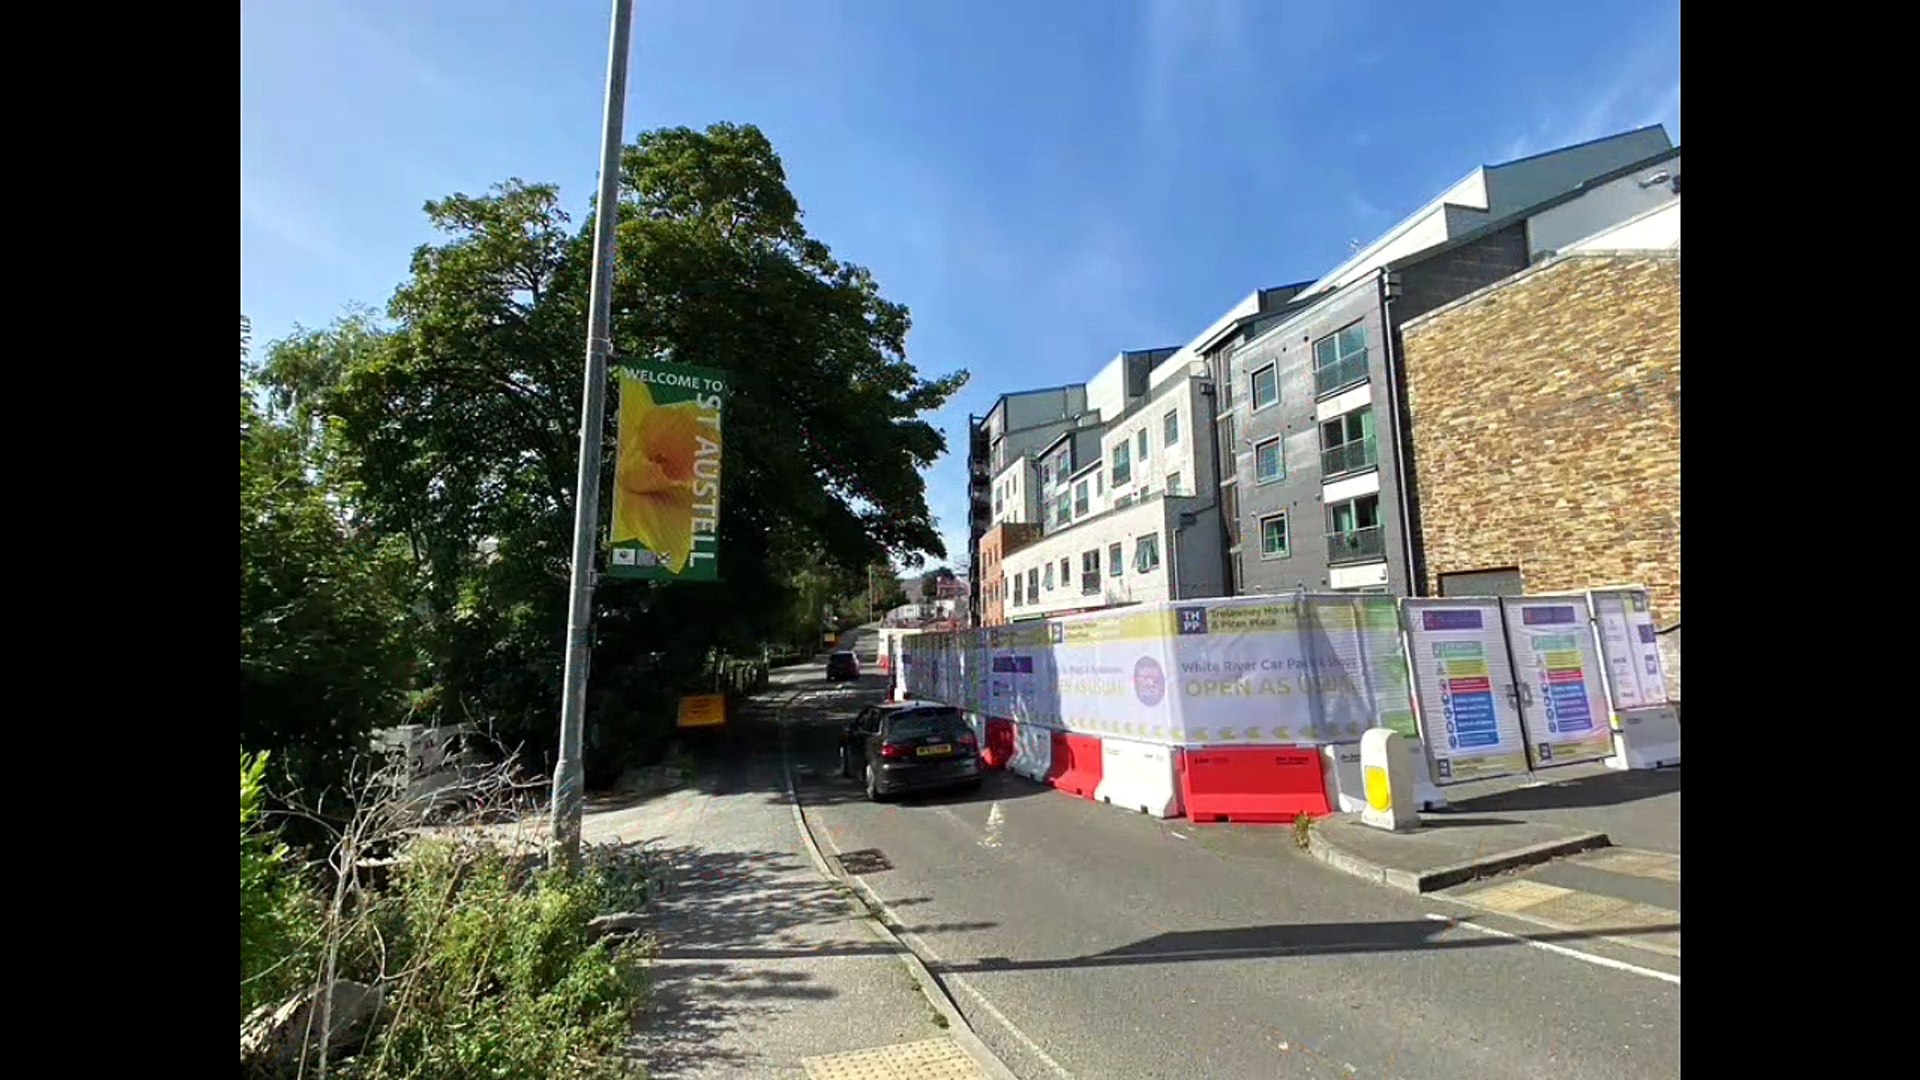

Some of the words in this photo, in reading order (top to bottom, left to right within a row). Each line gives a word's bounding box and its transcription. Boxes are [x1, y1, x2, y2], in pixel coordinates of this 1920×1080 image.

[624, 368, 700, 389] WELCOME
[703, 379, 723, 393] TO
[696, 393, 722, 431] ST
[690, 436, 722, 568] AUSTELL
[1182, 611, 1200, 621] TH
[1183, 621, 1200, 631] PP
[1181, 661, 1220, 674] White
[1223, 659, 1257, 673] River
[1260, 658, 1283, 670] Car
[1186, 679, 1252, 697] OPEN
[1260, 677, 1292, 696] AS
